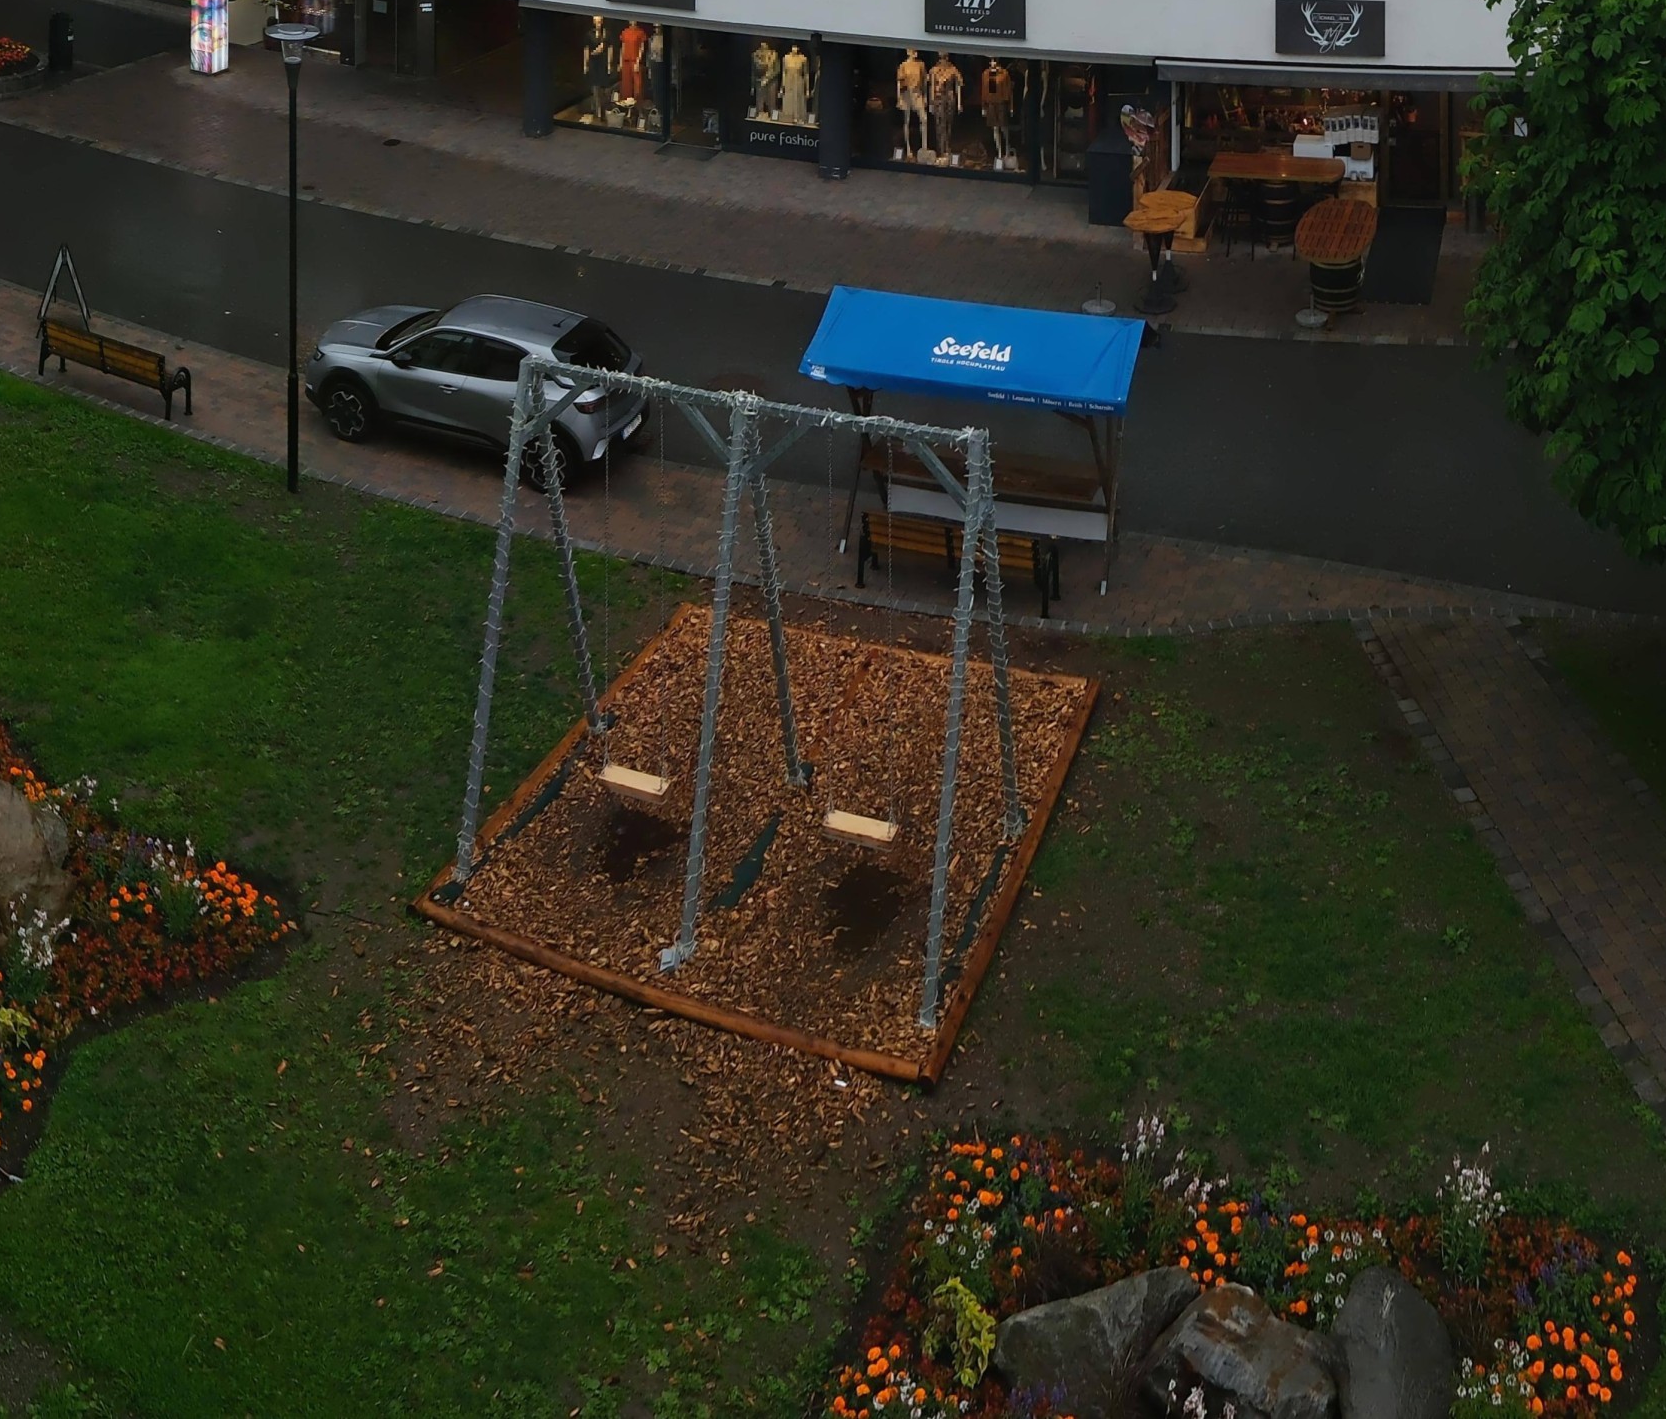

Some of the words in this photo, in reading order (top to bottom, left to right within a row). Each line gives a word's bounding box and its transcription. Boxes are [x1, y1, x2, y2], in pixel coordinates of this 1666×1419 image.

[934, 24, 962, 32] SEEFELD
[963, 26, 999, 34] SHOPPING
[1000, 28, 1017, 36] APP
[749, 131, 776, 143] pure
[933, 336, 1012, 363] Seefeld
